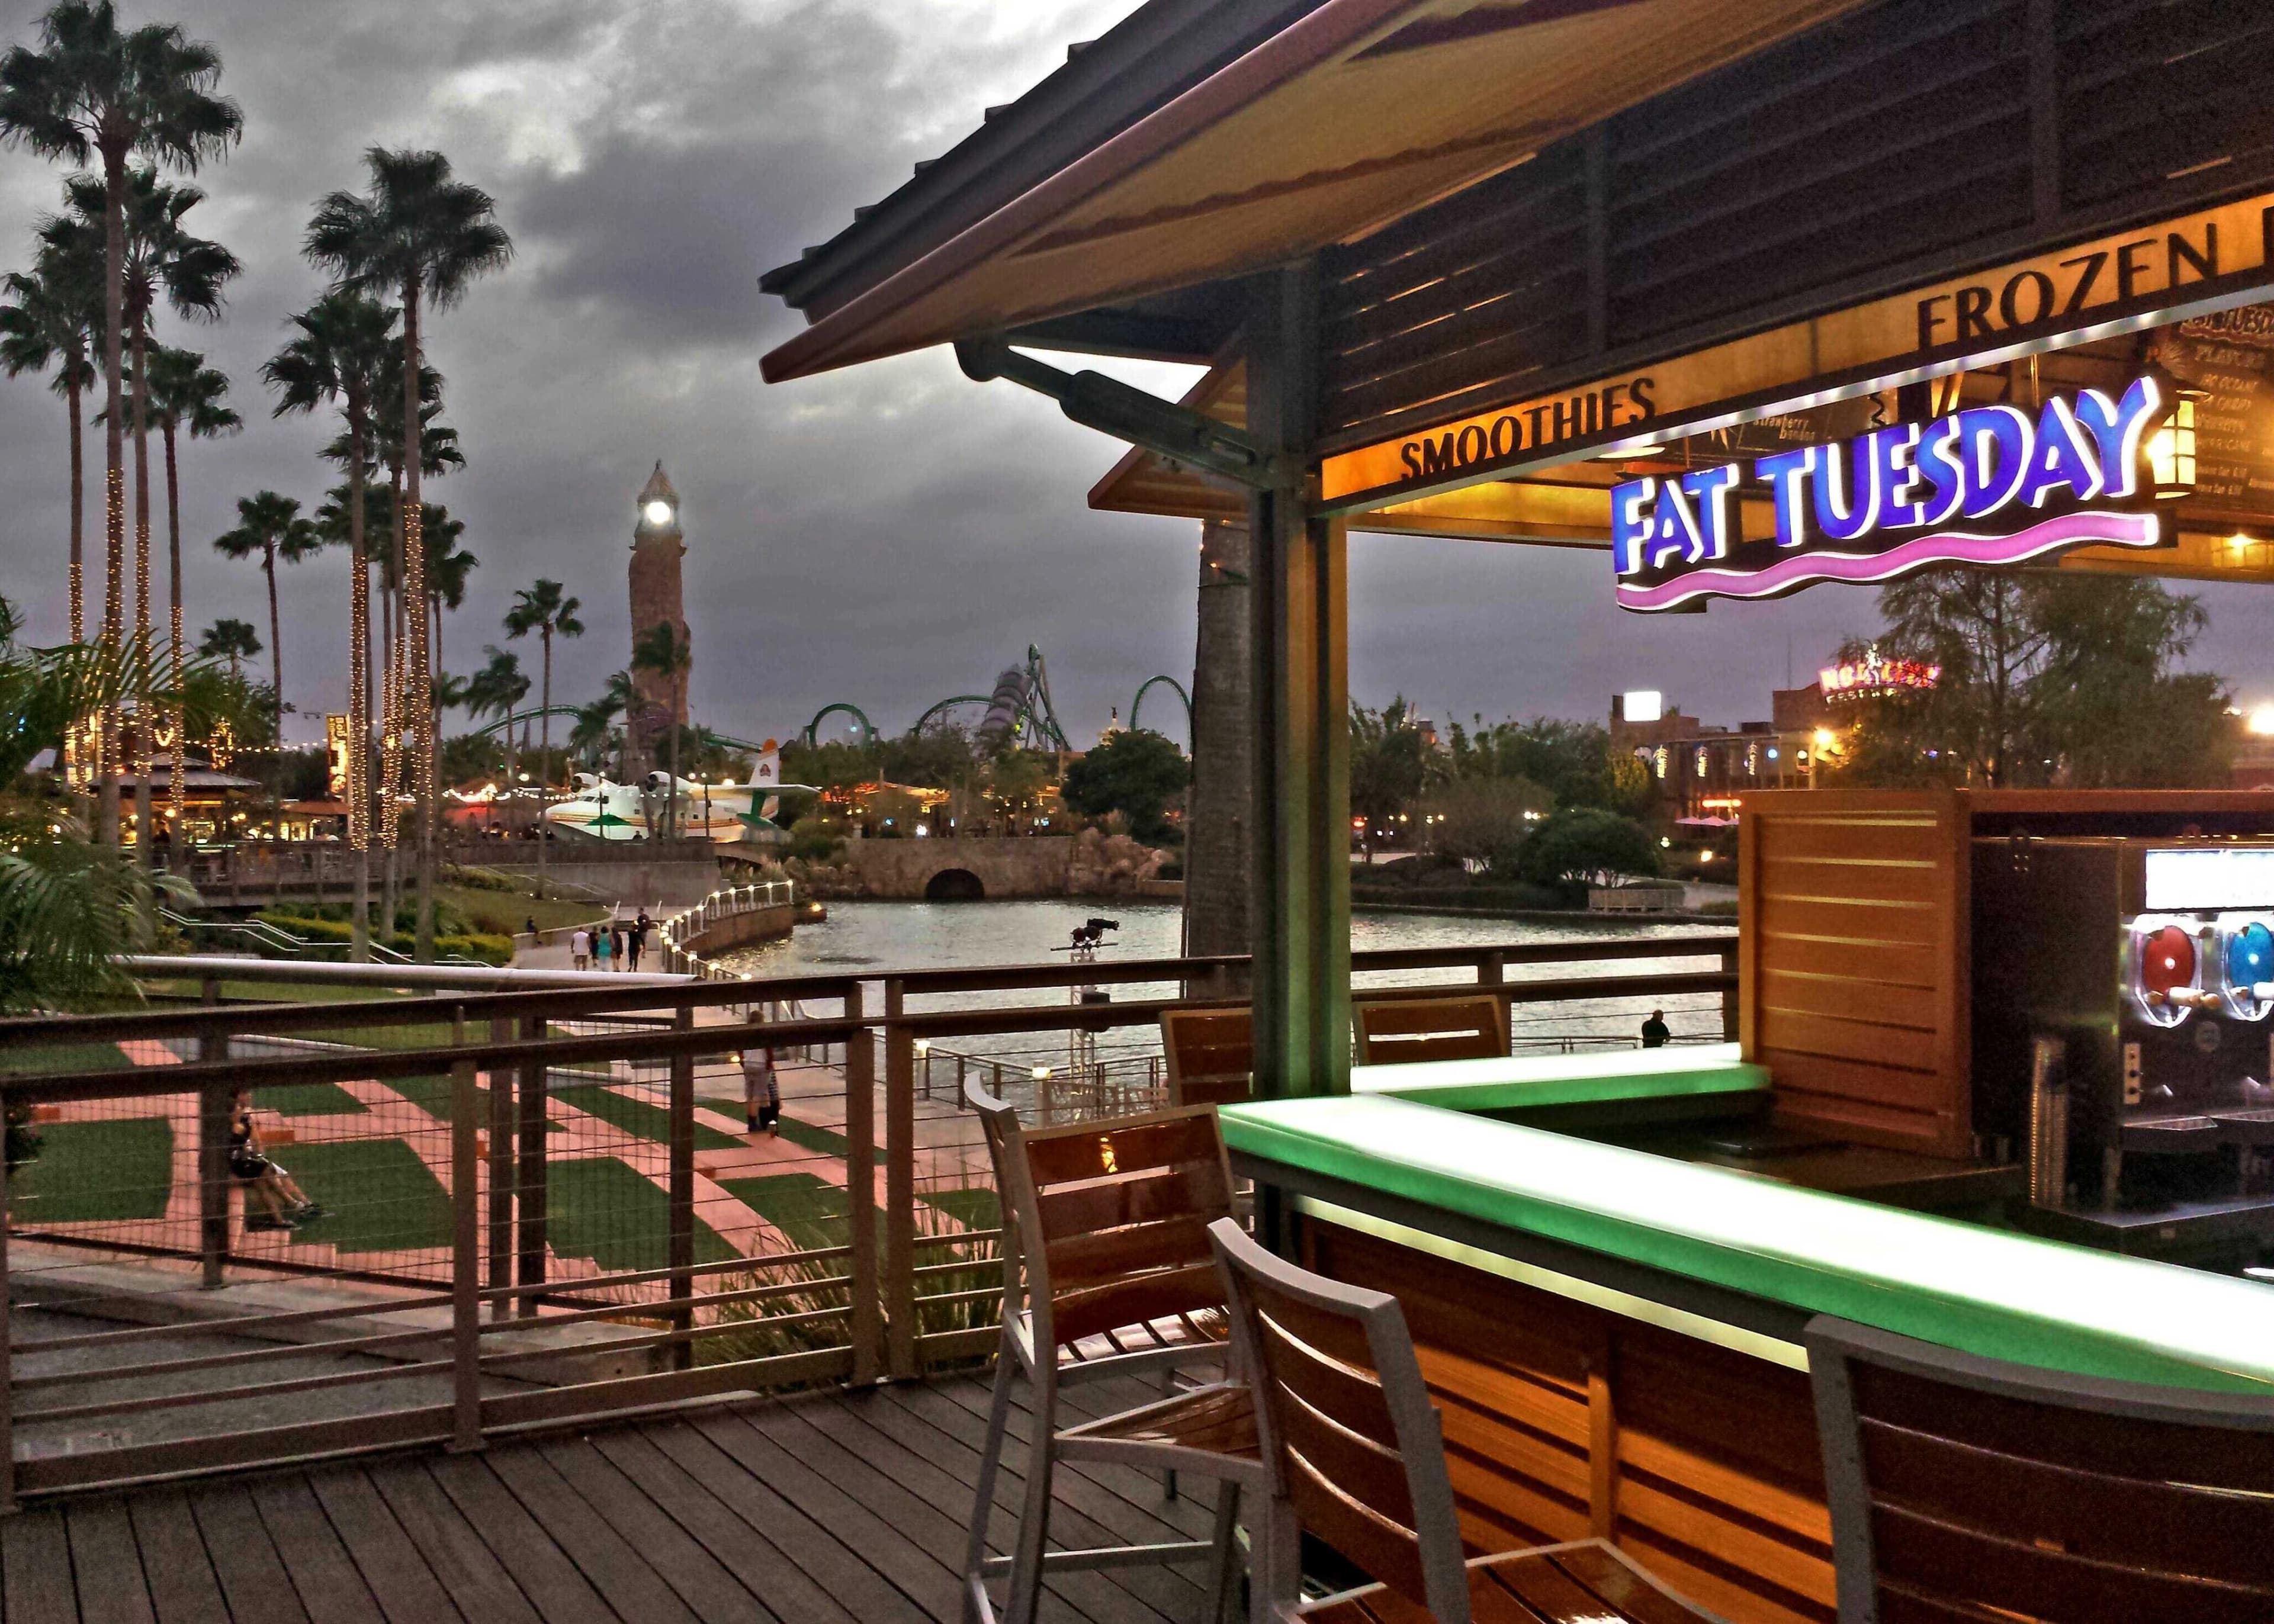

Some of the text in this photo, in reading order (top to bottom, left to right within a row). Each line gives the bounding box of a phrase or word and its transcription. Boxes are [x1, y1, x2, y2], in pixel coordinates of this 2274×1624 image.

[1918, 221, 2218, 350] FROZEN
[1401, 378, 1656, 481] SMOOTHIES
[1611, 376, 2160, 574] FAT TUESDAY
